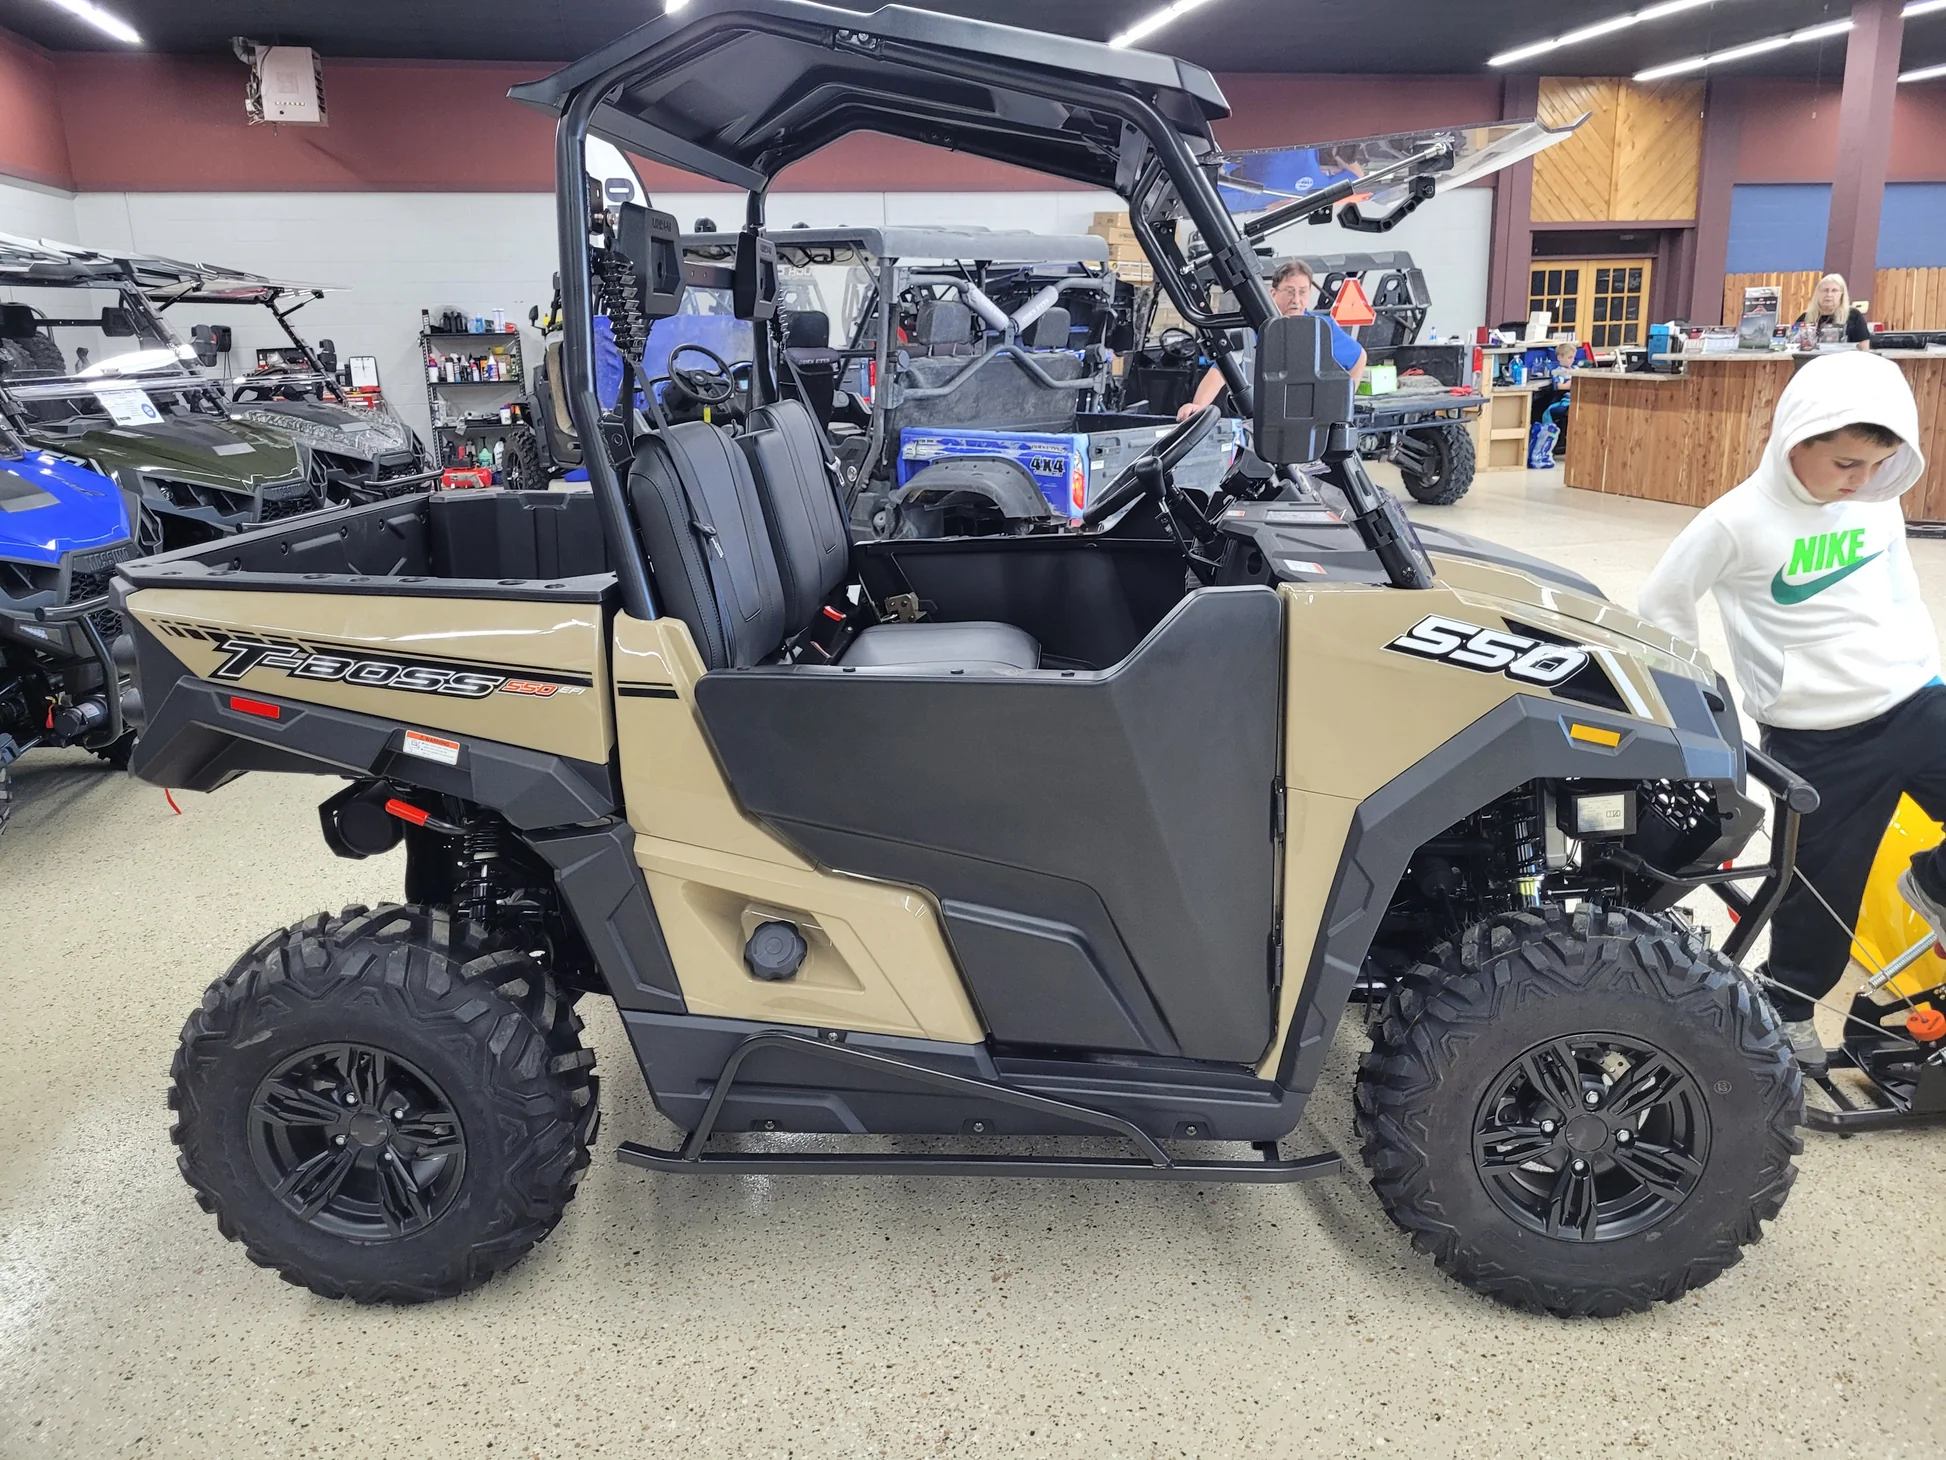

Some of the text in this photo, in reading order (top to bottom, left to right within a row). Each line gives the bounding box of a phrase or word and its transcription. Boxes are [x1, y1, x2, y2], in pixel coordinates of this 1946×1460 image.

[1030, 456, 1064, 473] 4X4
[1787, 528, 1865, 576] NIKE
[212, 640, 586, 697] T-BOSS 550 EFI
[1390, 614, 1588, 684] 550
[425, 736, 449, 748] WARNING
